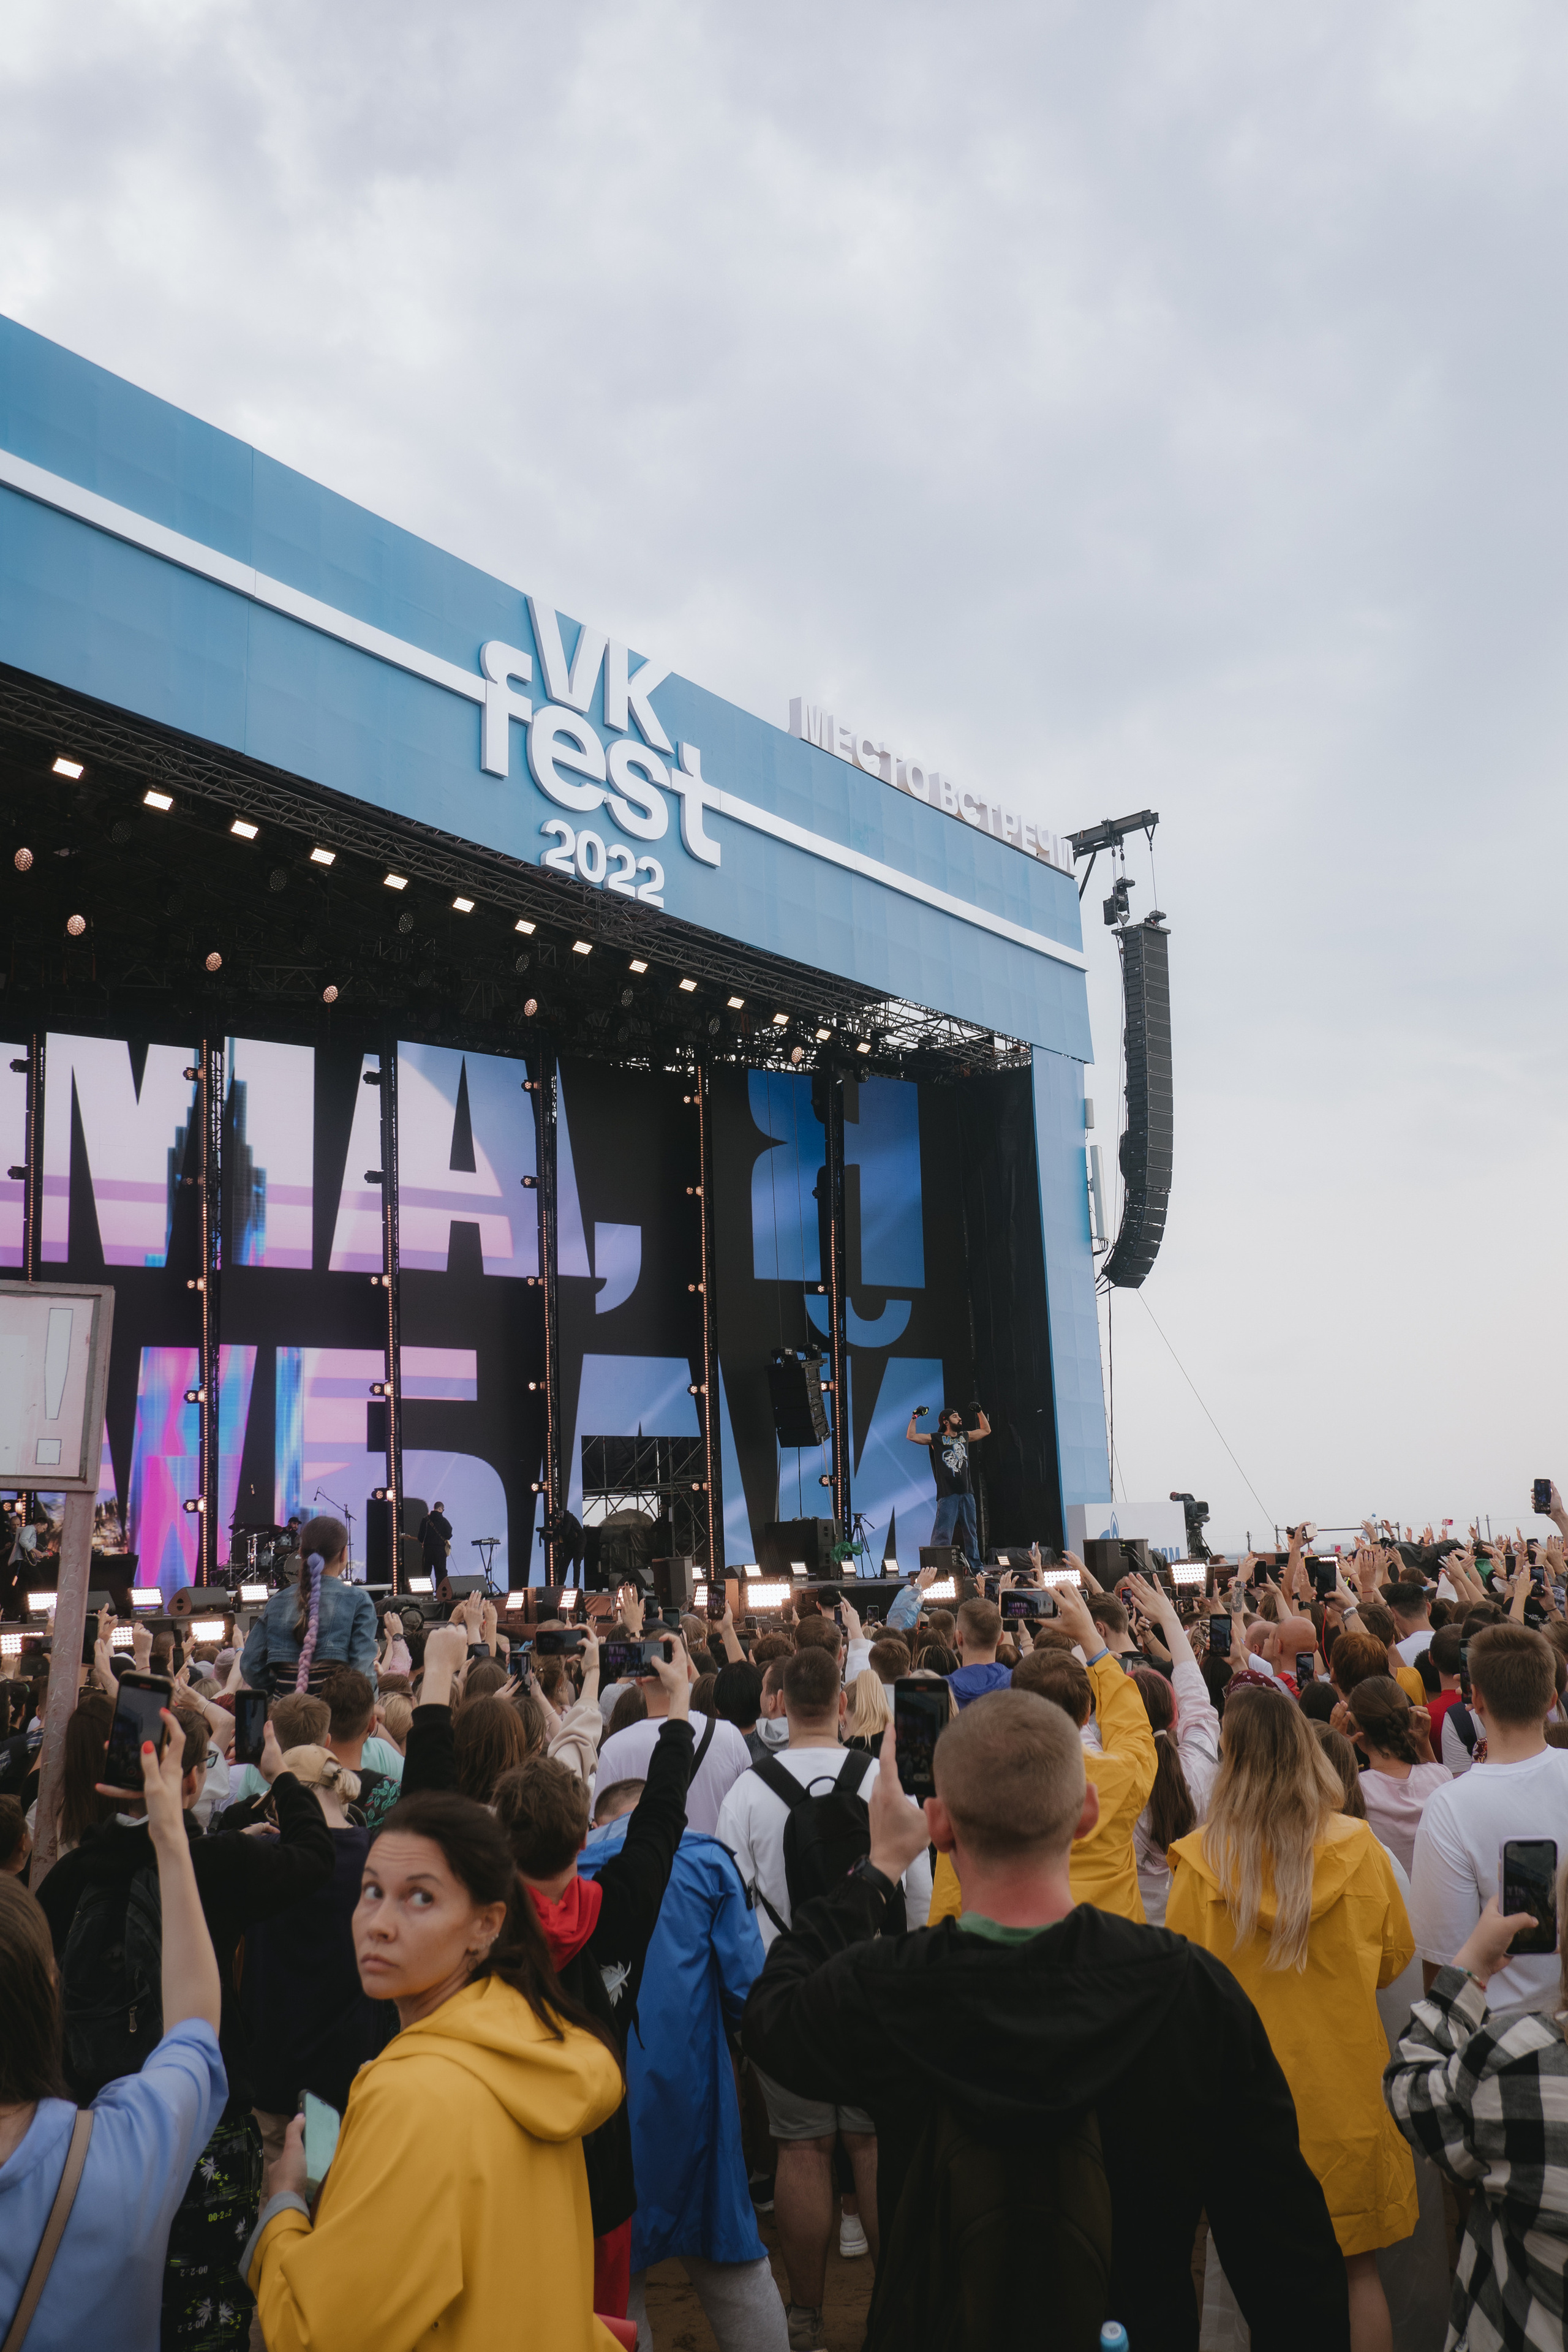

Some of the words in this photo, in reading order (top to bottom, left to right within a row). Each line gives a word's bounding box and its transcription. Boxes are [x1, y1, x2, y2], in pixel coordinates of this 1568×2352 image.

[480, 640, 721, 869] fest
[525, 596, 675, 757] VK
[539, 819, 665, 910] 2022
[789, 696, 930, 804] МЕСТО
[928, 772, 1075, 873] ВСТРЕЧИ
